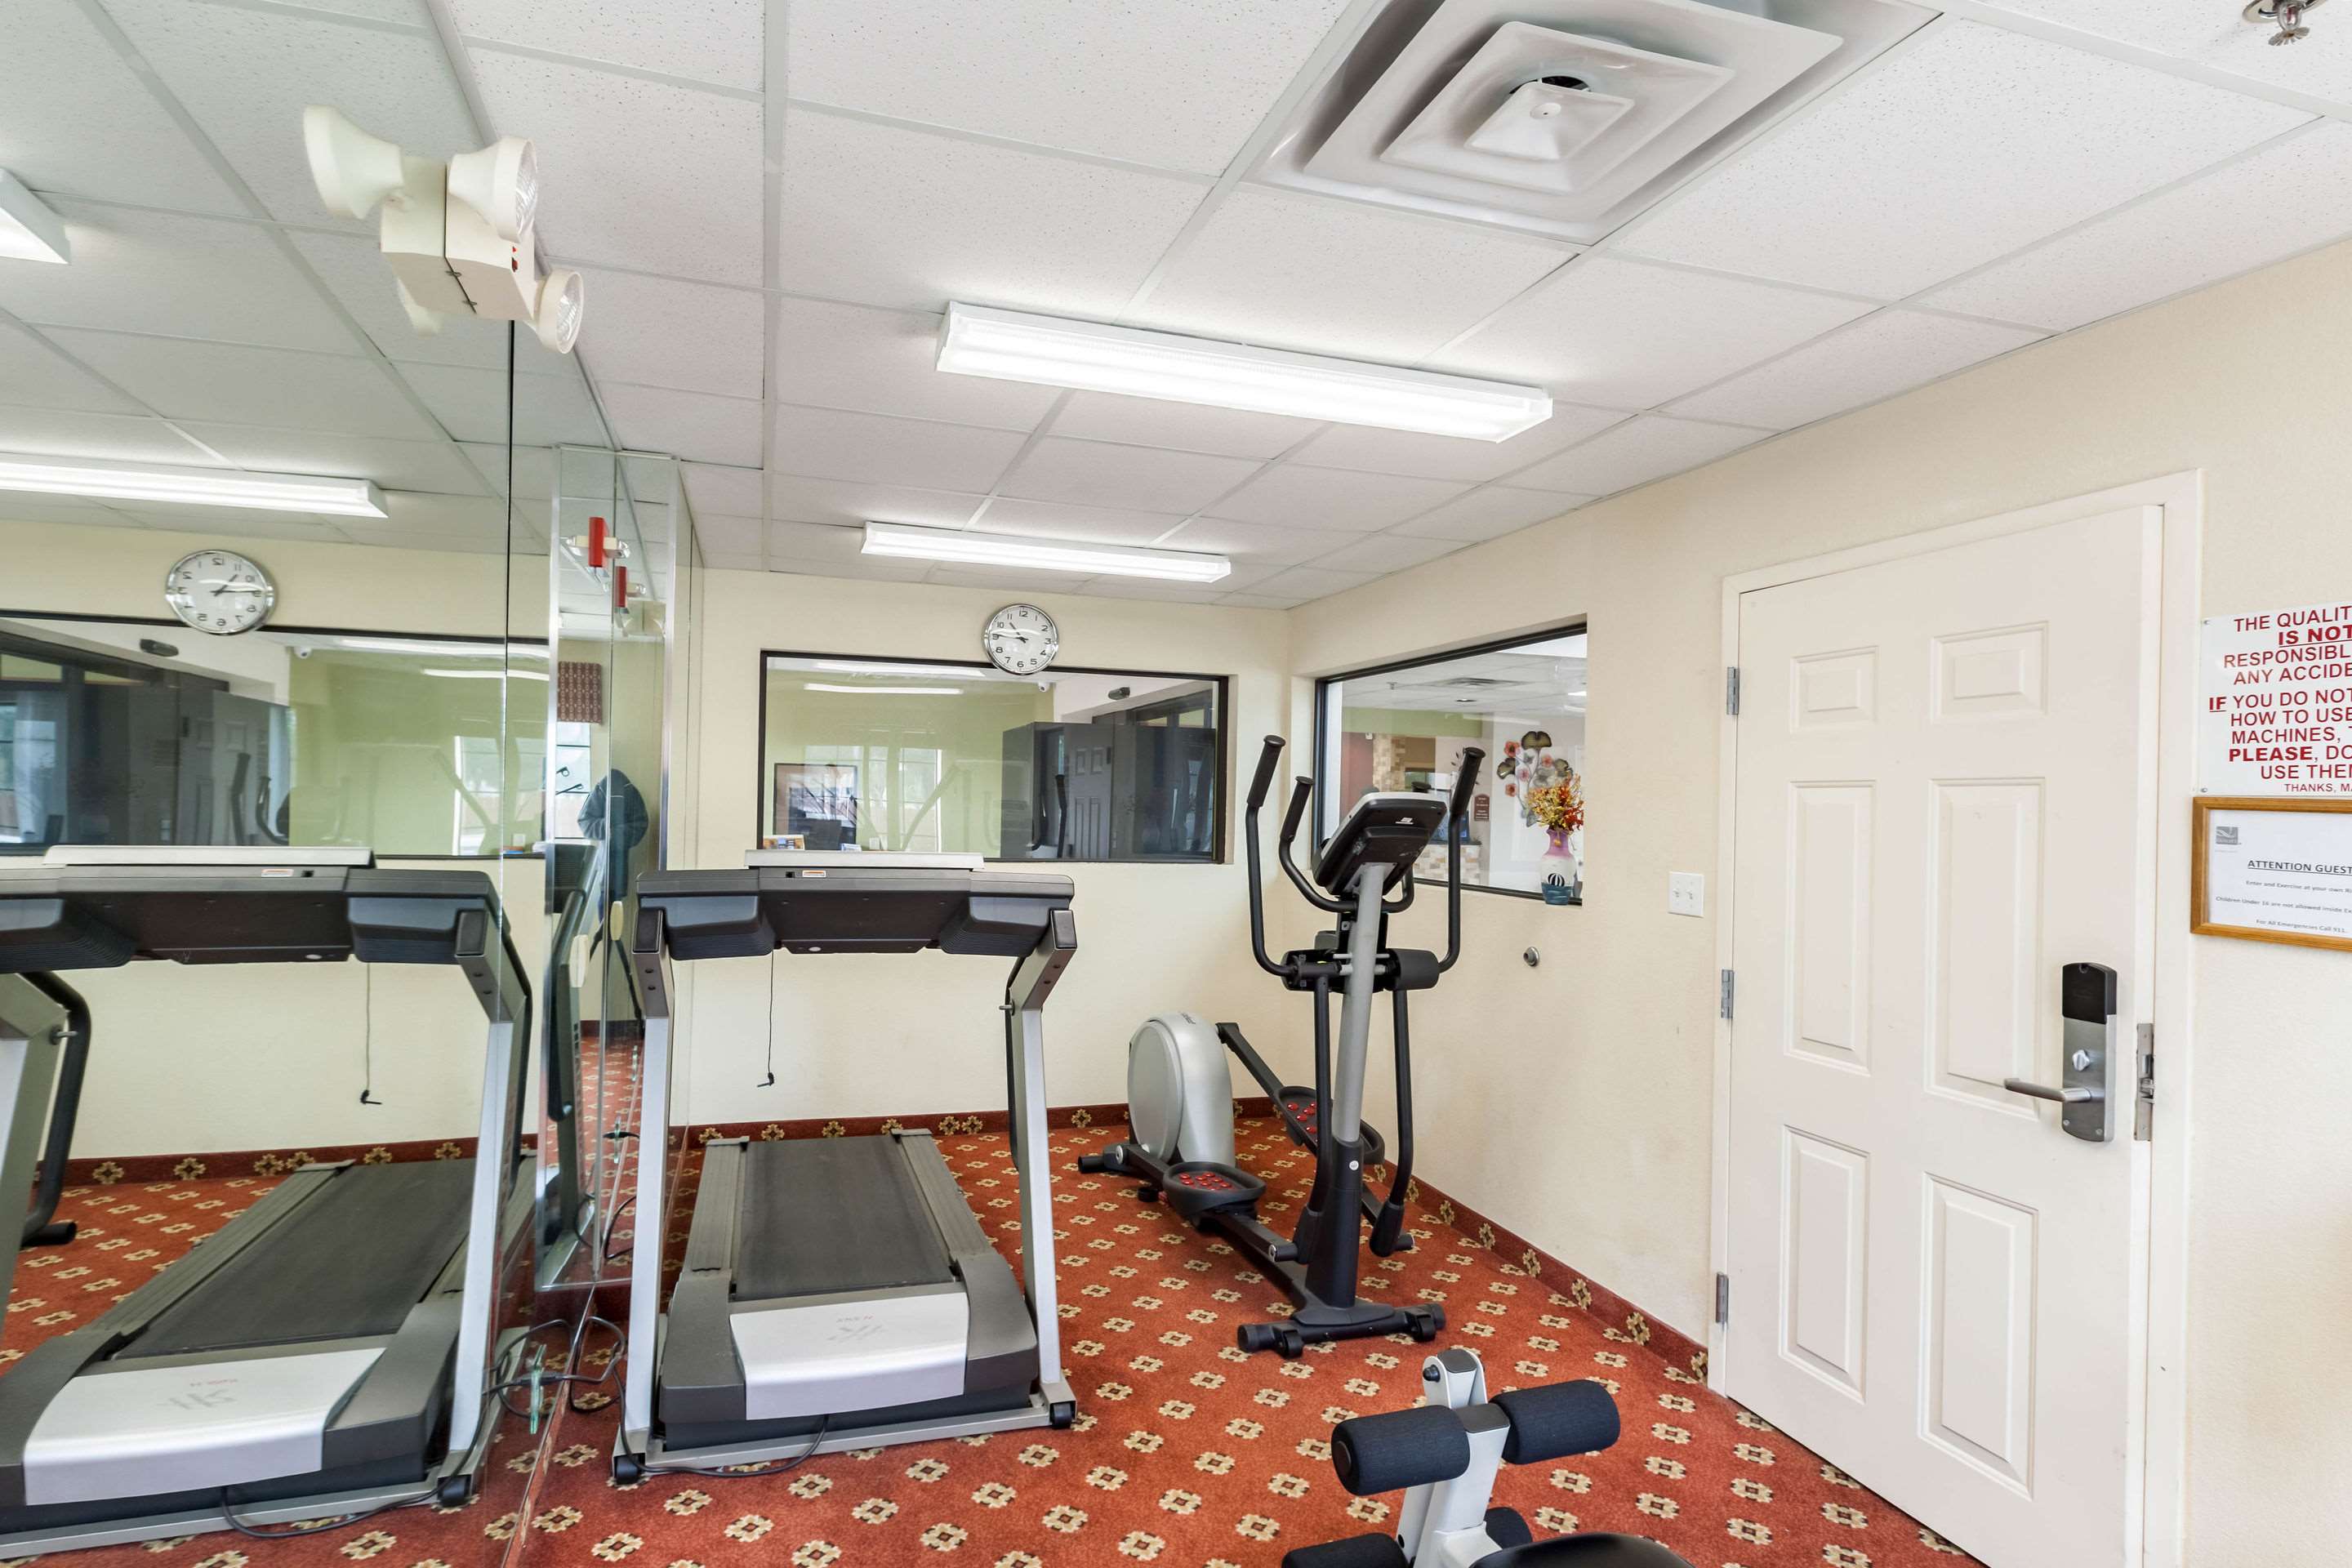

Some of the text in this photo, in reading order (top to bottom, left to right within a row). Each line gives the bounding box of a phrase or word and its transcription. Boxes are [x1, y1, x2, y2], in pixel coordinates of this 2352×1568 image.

[2234, 605, 2352, 632] THE QUALIT
[2278, 625, 2352, 645] IS NOT
[2225, 644, 2351, 668] RESPONSIBL
[2234, 662, 2352, 685] ANY ACCIDE
[2209, 688, 2352, 710] IF YOU DO NOT
[2231, 707, 2352, 727] HOW TO USE
[2231, 726, 2341, 744] MACHINES,
[2229, 745, 2352, 763] PLEASE, DO
[2261, 764, 2352, 779] USE THE
[2284, 783, 2336, 793] THANKS,
[2247, 860, 2352, 874] ATTENTION GUEST
